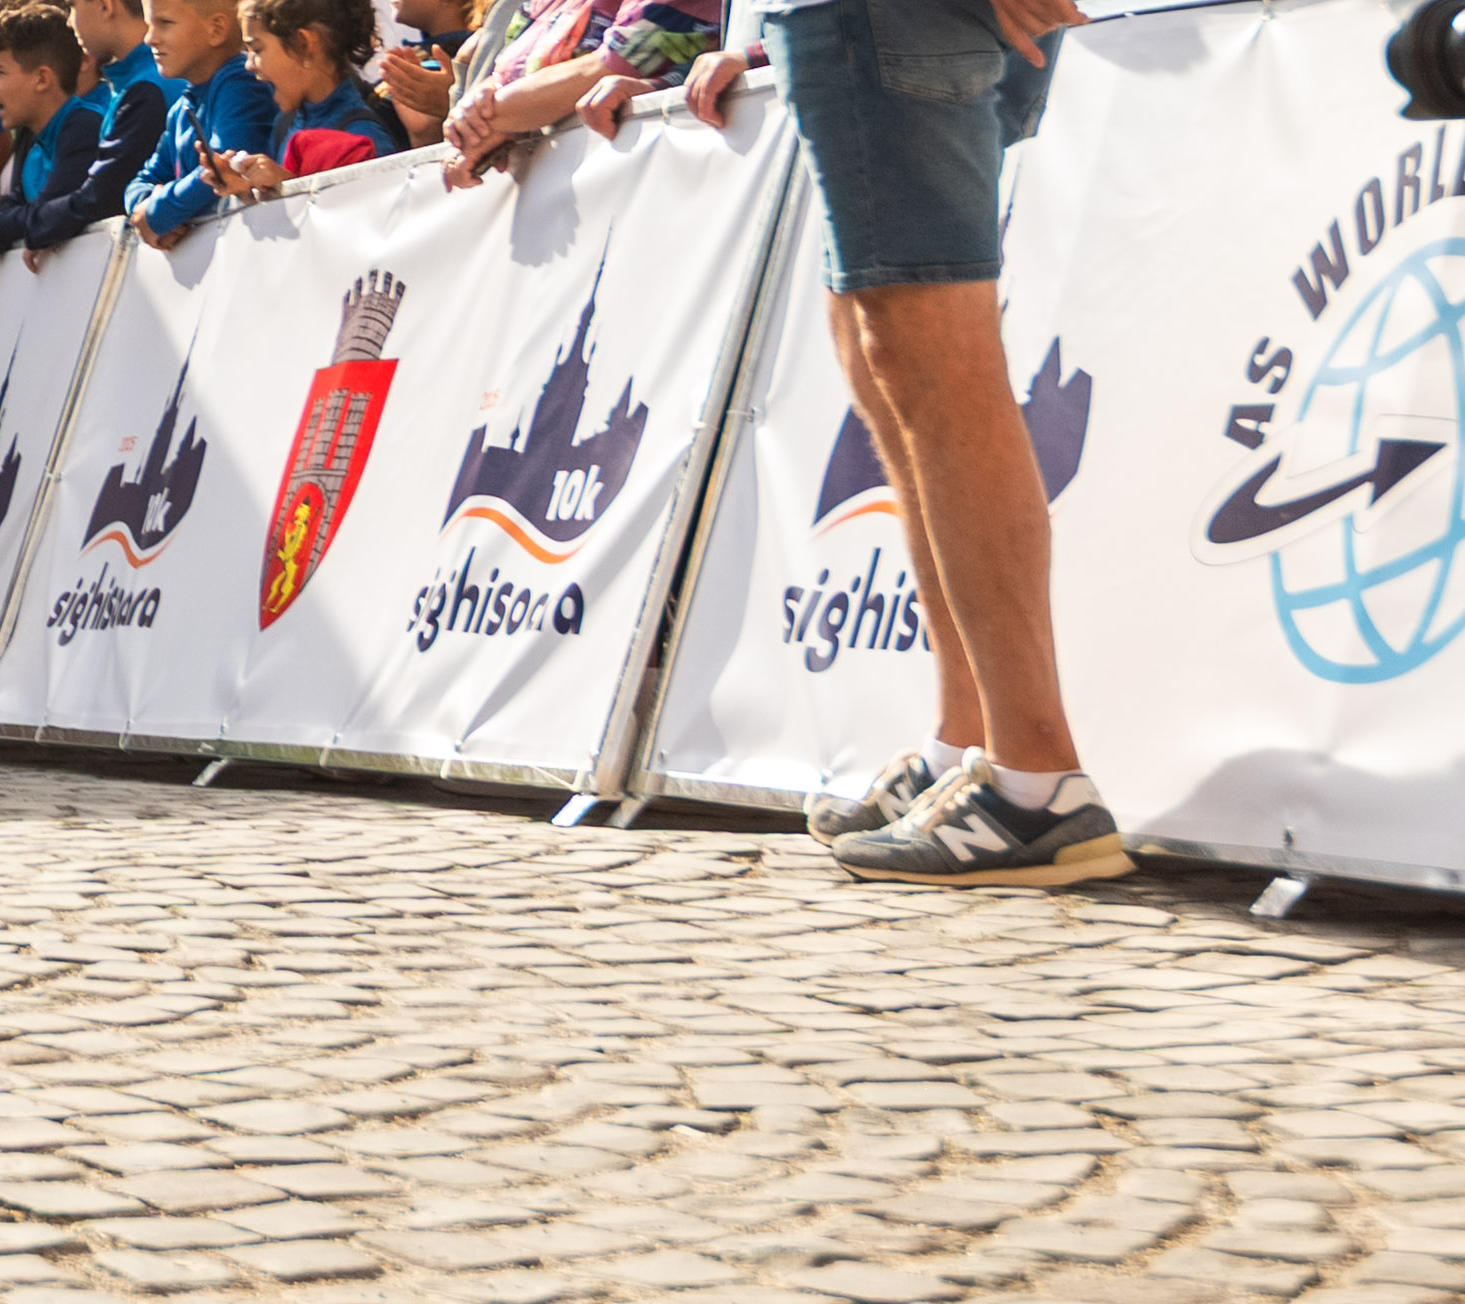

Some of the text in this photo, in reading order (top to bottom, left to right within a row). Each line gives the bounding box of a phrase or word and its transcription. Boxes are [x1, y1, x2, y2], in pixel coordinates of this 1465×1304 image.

[1223, 336, 1293, 451] AS
[545, 464, 605, 522] 10k
[783, 547, 931, 673] sighis
